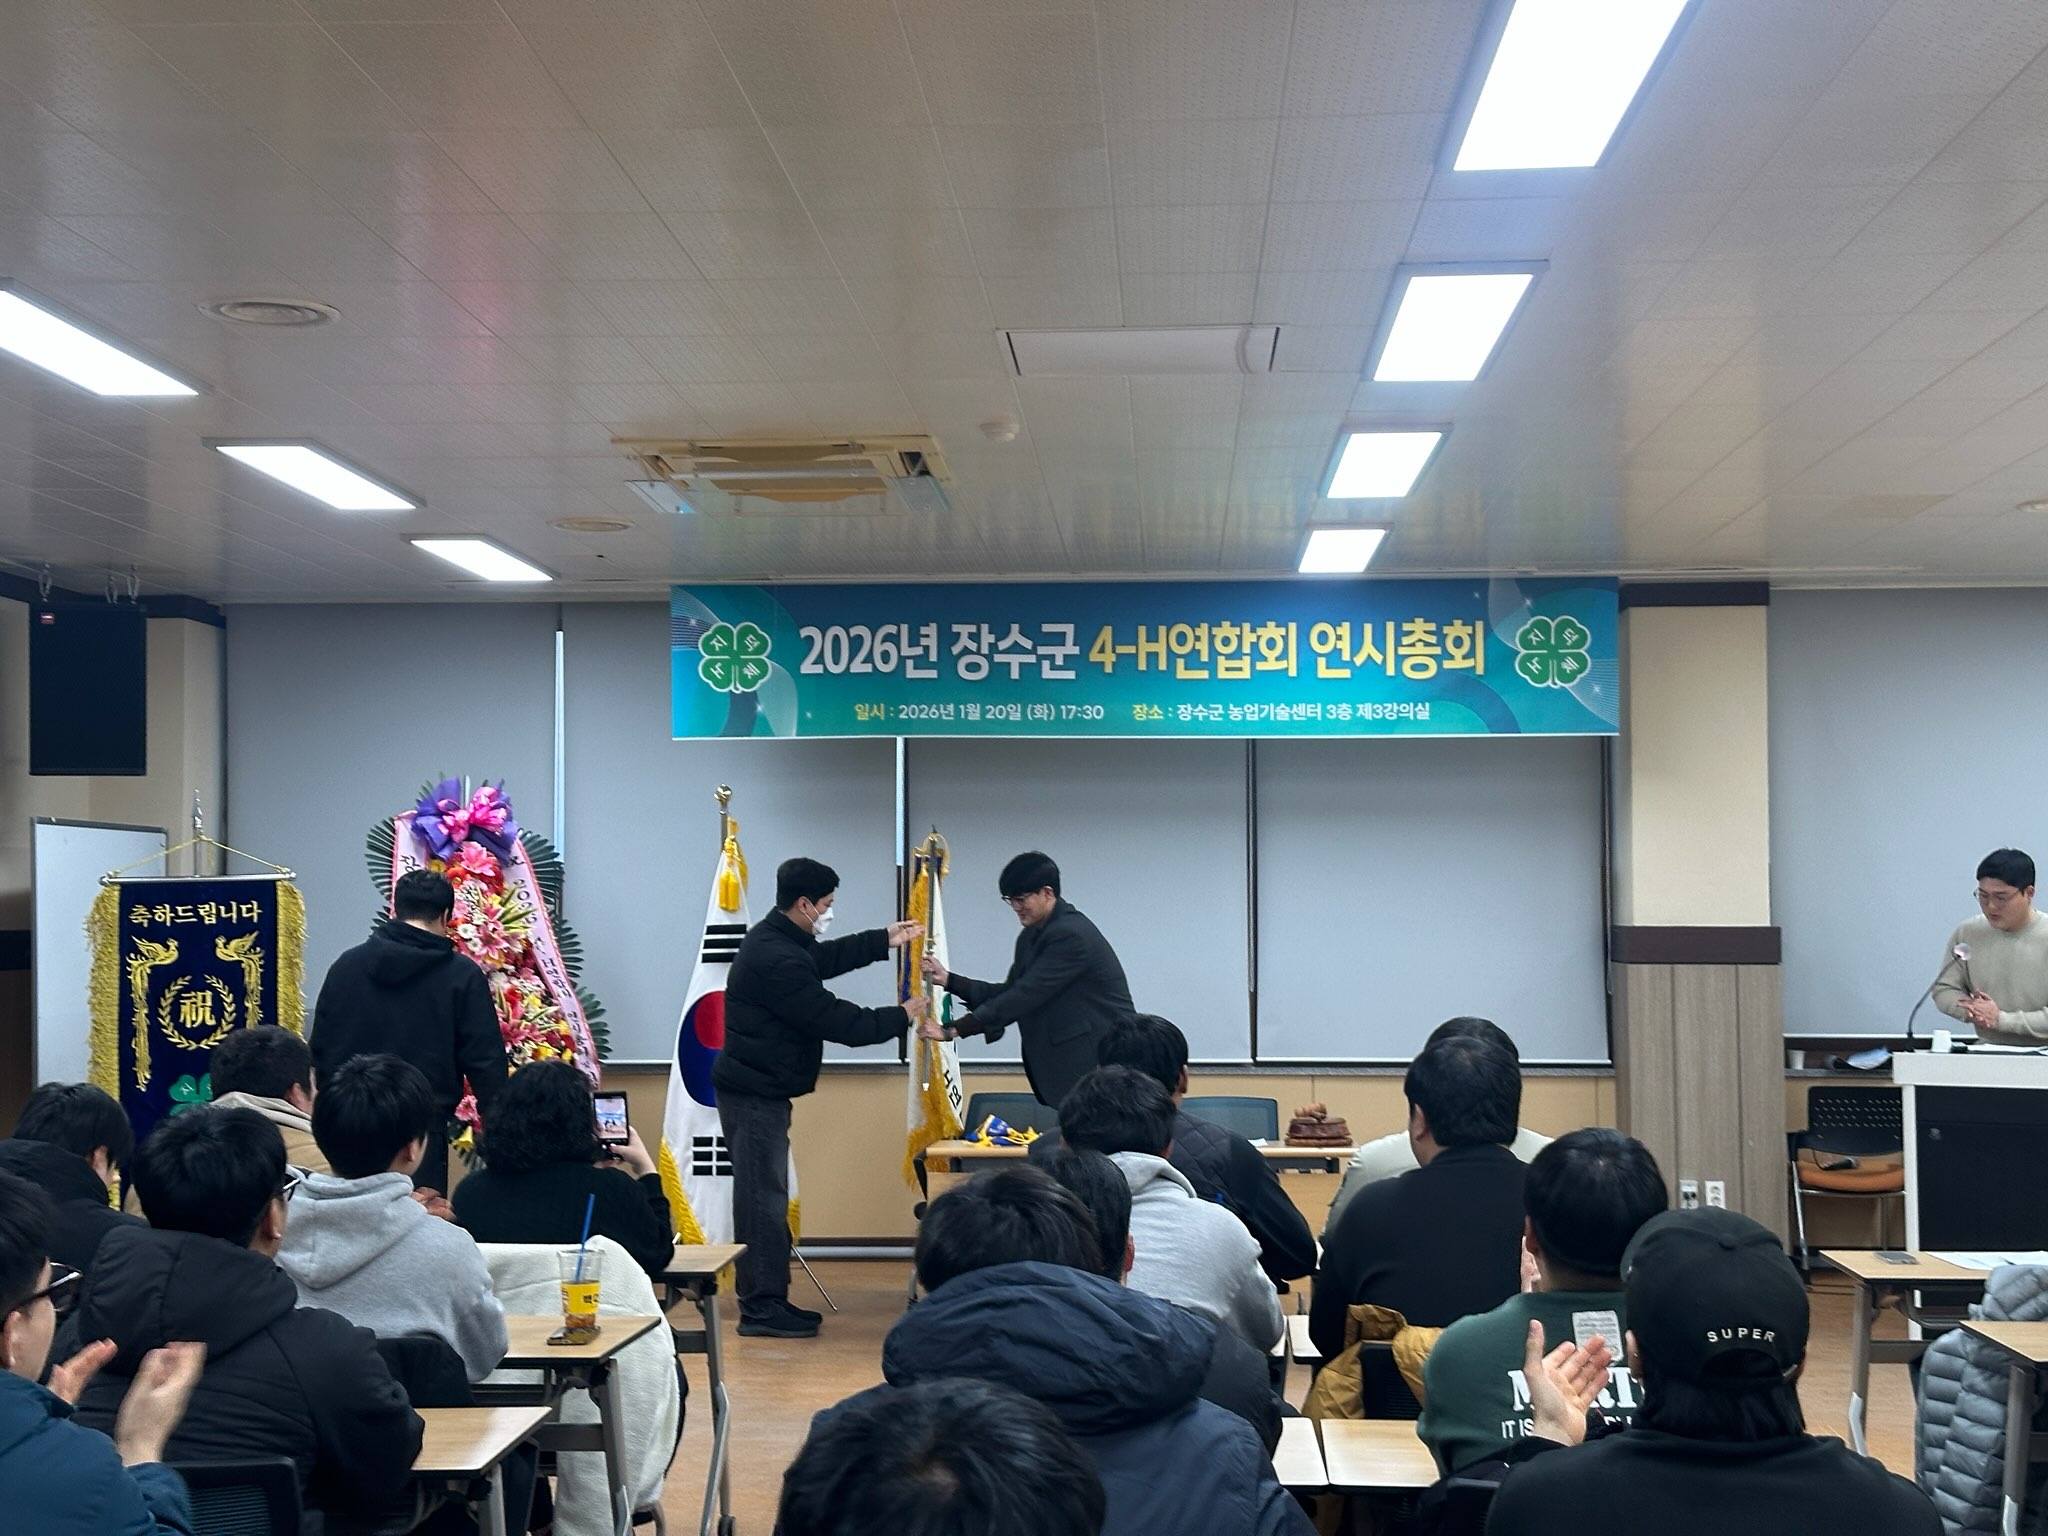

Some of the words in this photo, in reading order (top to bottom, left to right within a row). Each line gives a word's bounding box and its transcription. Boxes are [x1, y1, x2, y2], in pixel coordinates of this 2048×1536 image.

[799, 623, 938, 679] 2026년
[951, 623, 1080, 680] 장수군
[1089, 621, 1298, 680] 4-H연합회
[1309, 617, 1486, 680] 연시총회
[855, 703, 885, 721] 일시
[898, 703, 954, 720] 2026년
[958, 703, 981, 721] 1월
[985, 703, 1021, 721] 20일
[1026, 703, 1055, 721] (화)
[1060, 704, 1105, 720] 17:30
[1132, 703, 1164, 721] 장소
[1177, 703, 1225, 721] 장수군
[1227, 702, 1322, 721] 농업기술센터
[1325, 703, 1353, 721] 3층
[1356, 702, 1431, 721] 제3강의실
[128, 900, 263, 928] 축하드립니다
[179, 990, 217, 1028] 祝
[1706, 1327, 1776, 1343] SUPER
